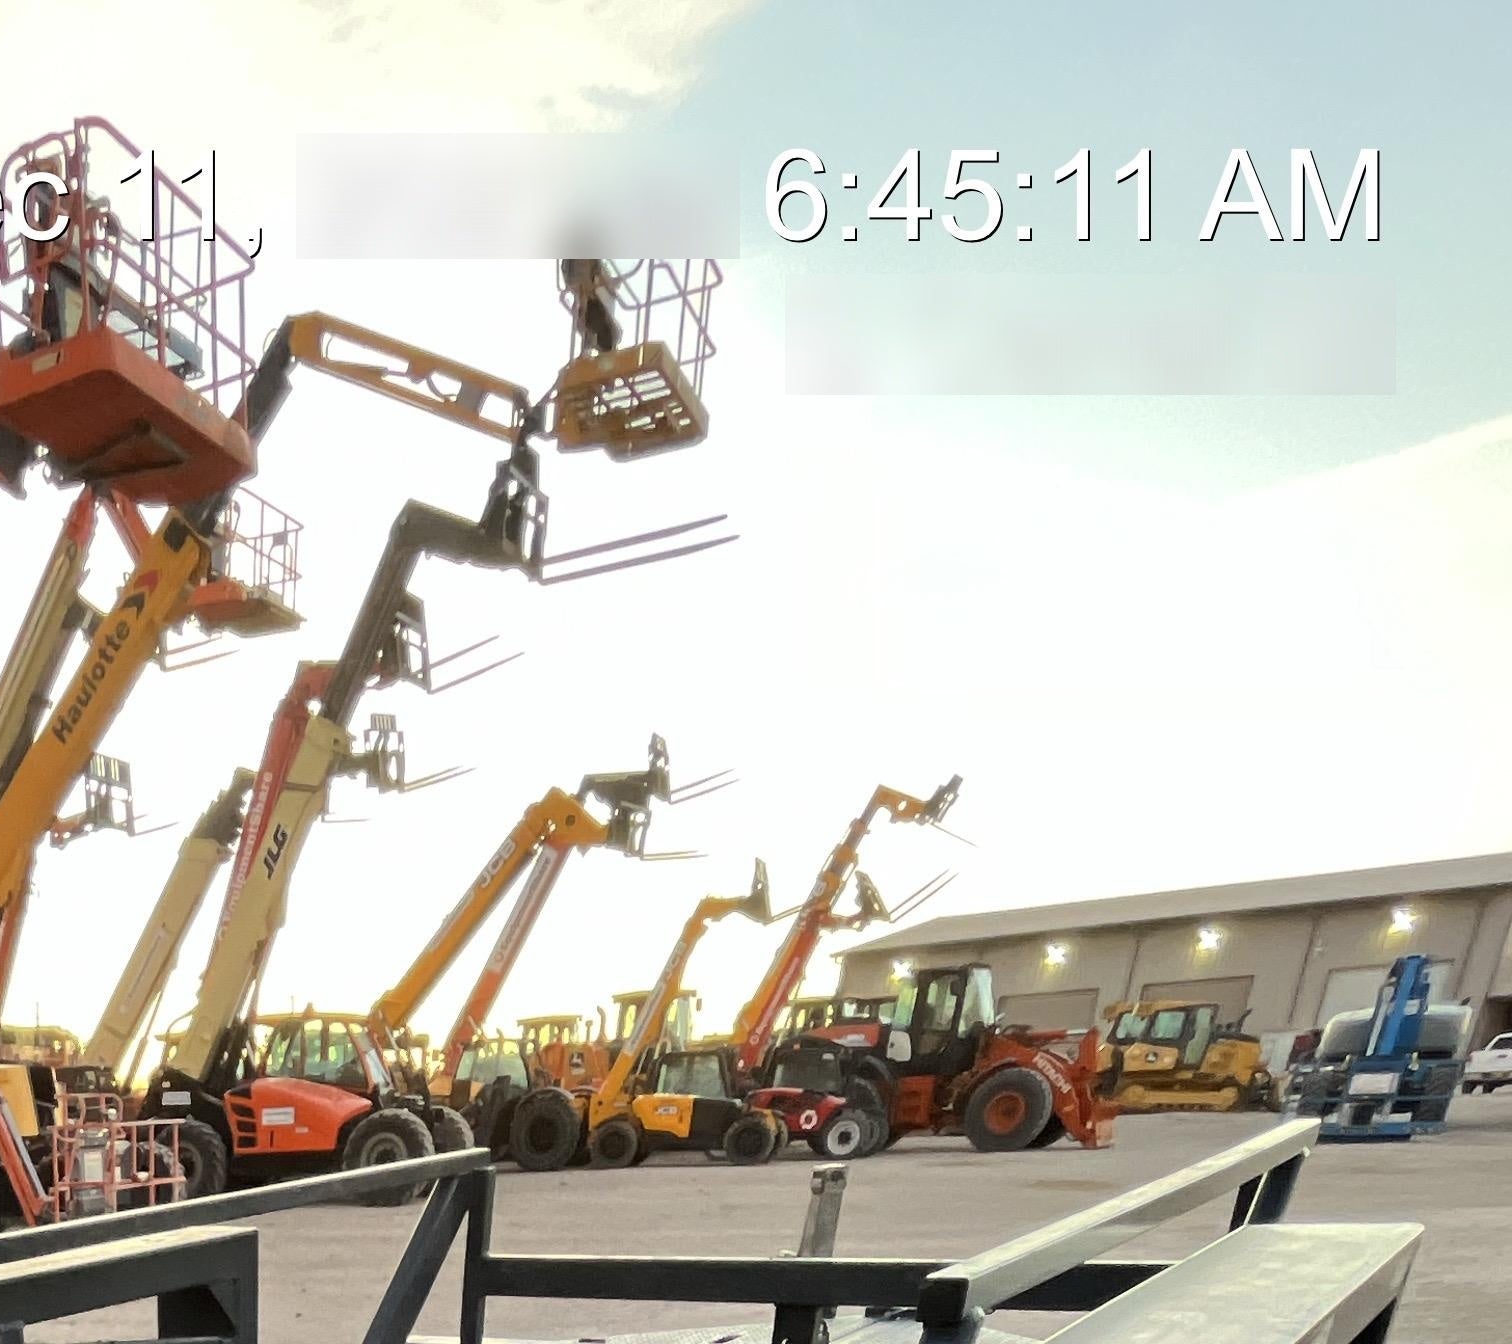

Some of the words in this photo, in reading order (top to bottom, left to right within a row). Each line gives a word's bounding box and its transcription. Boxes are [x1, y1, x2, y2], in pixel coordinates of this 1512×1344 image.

[51, 618, 131, 744] Haulotte
[264, 822, 289, 881] JLG
[479, 840, 516, 888] JCB
